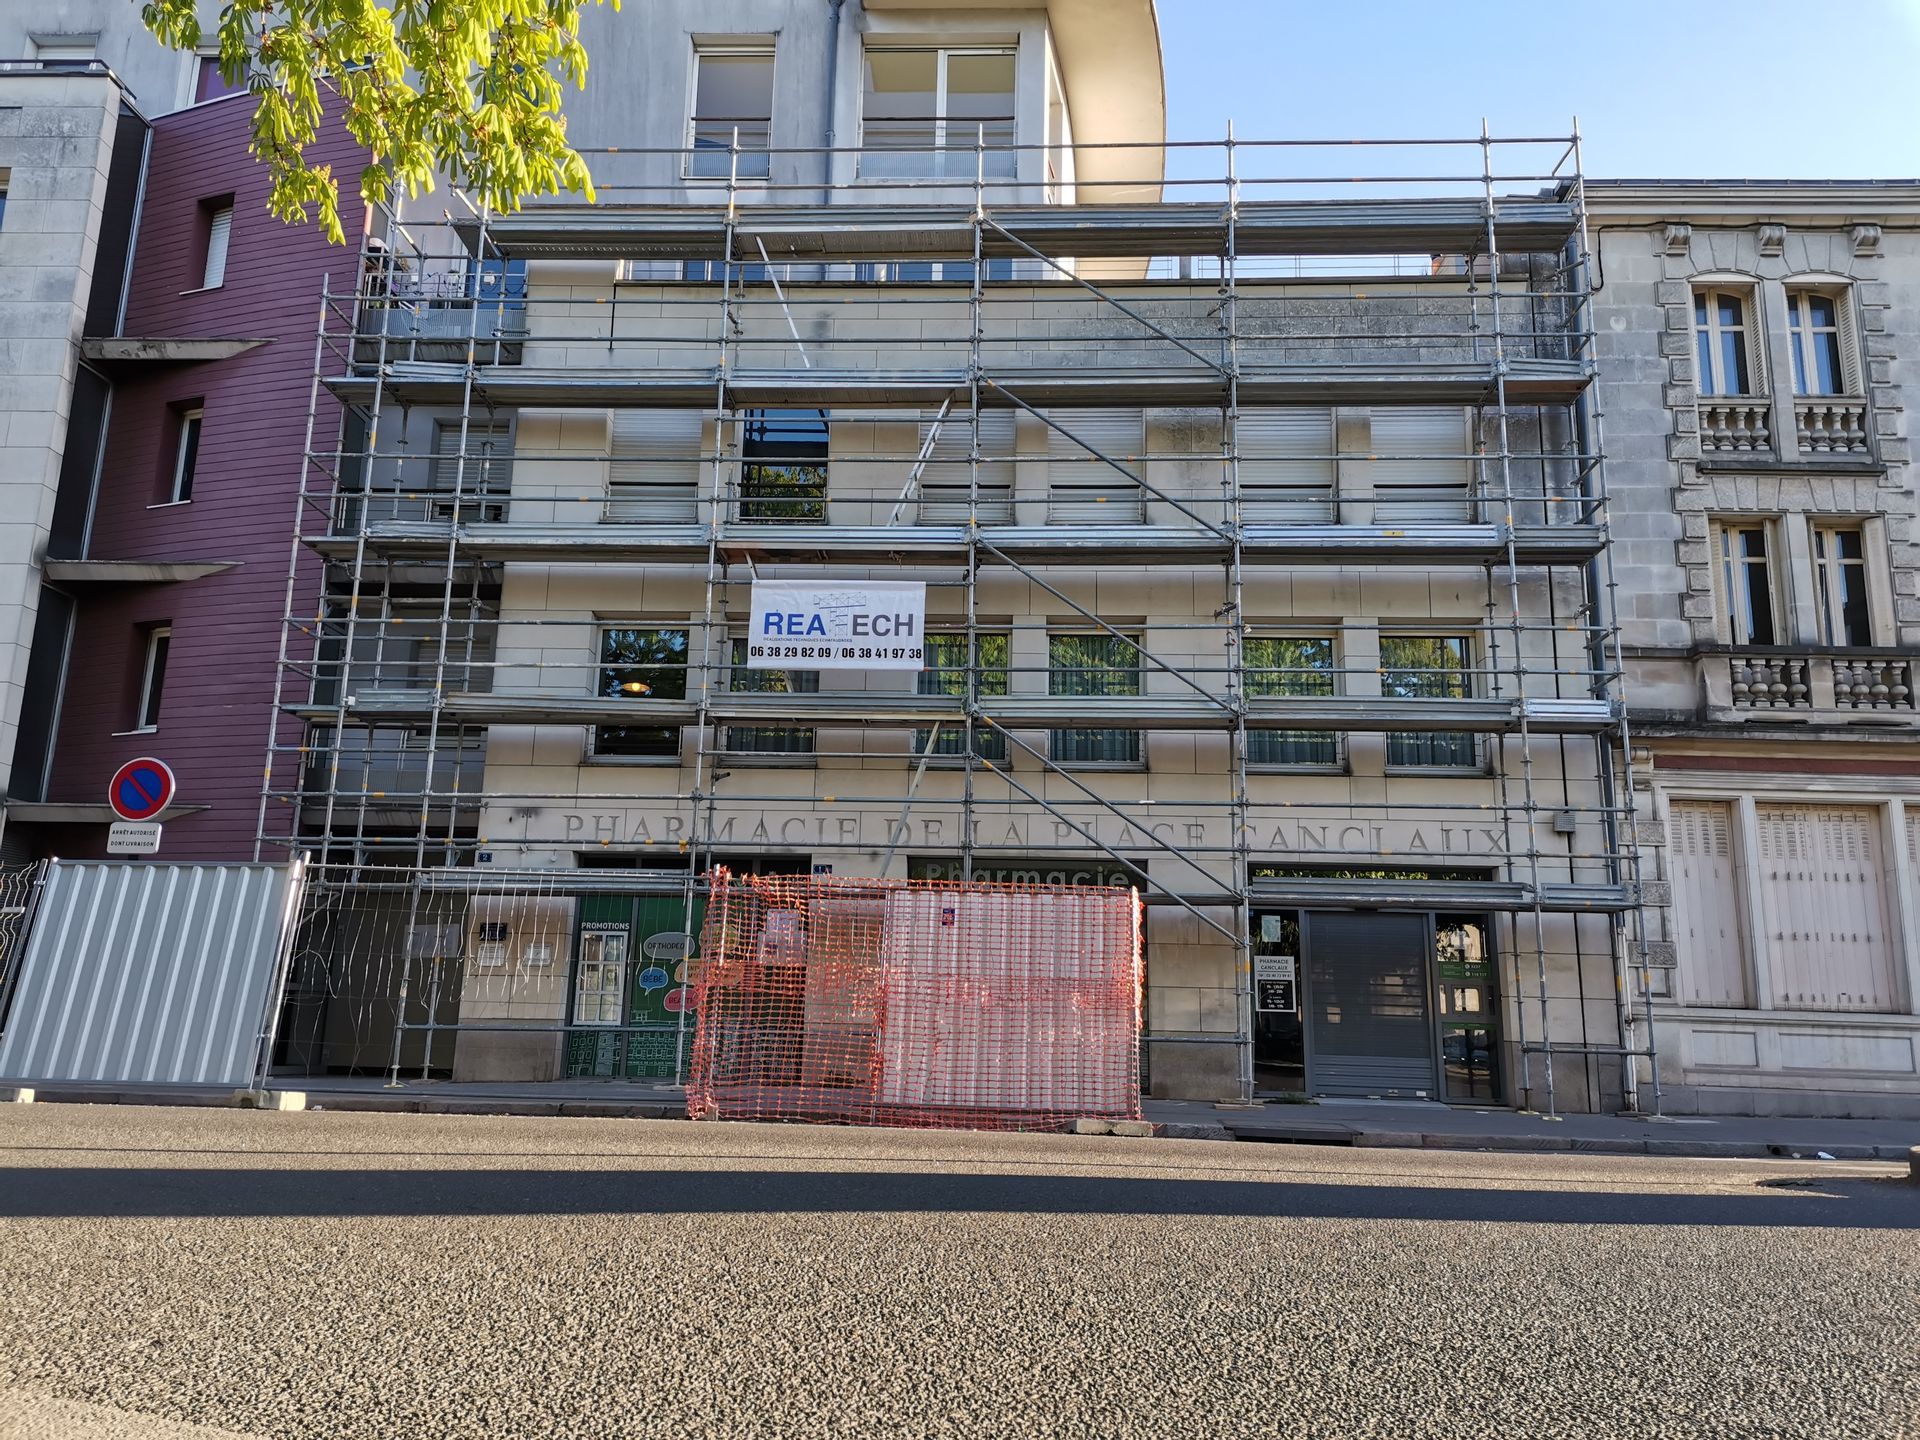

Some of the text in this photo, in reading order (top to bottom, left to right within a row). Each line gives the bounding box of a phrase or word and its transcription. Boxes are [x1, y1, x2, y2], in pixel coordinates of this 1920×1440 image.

[751, 646, 922, 659] 06 38 29 82 09 / 06 38 41 97 38
[562, 815, 1508, 853] PHARMACIE DE LA PLACE CANCLAUX
[926, 863, 1130, 887] Pharmacie
[581, 922, 630, 930] PROMOTIONS
